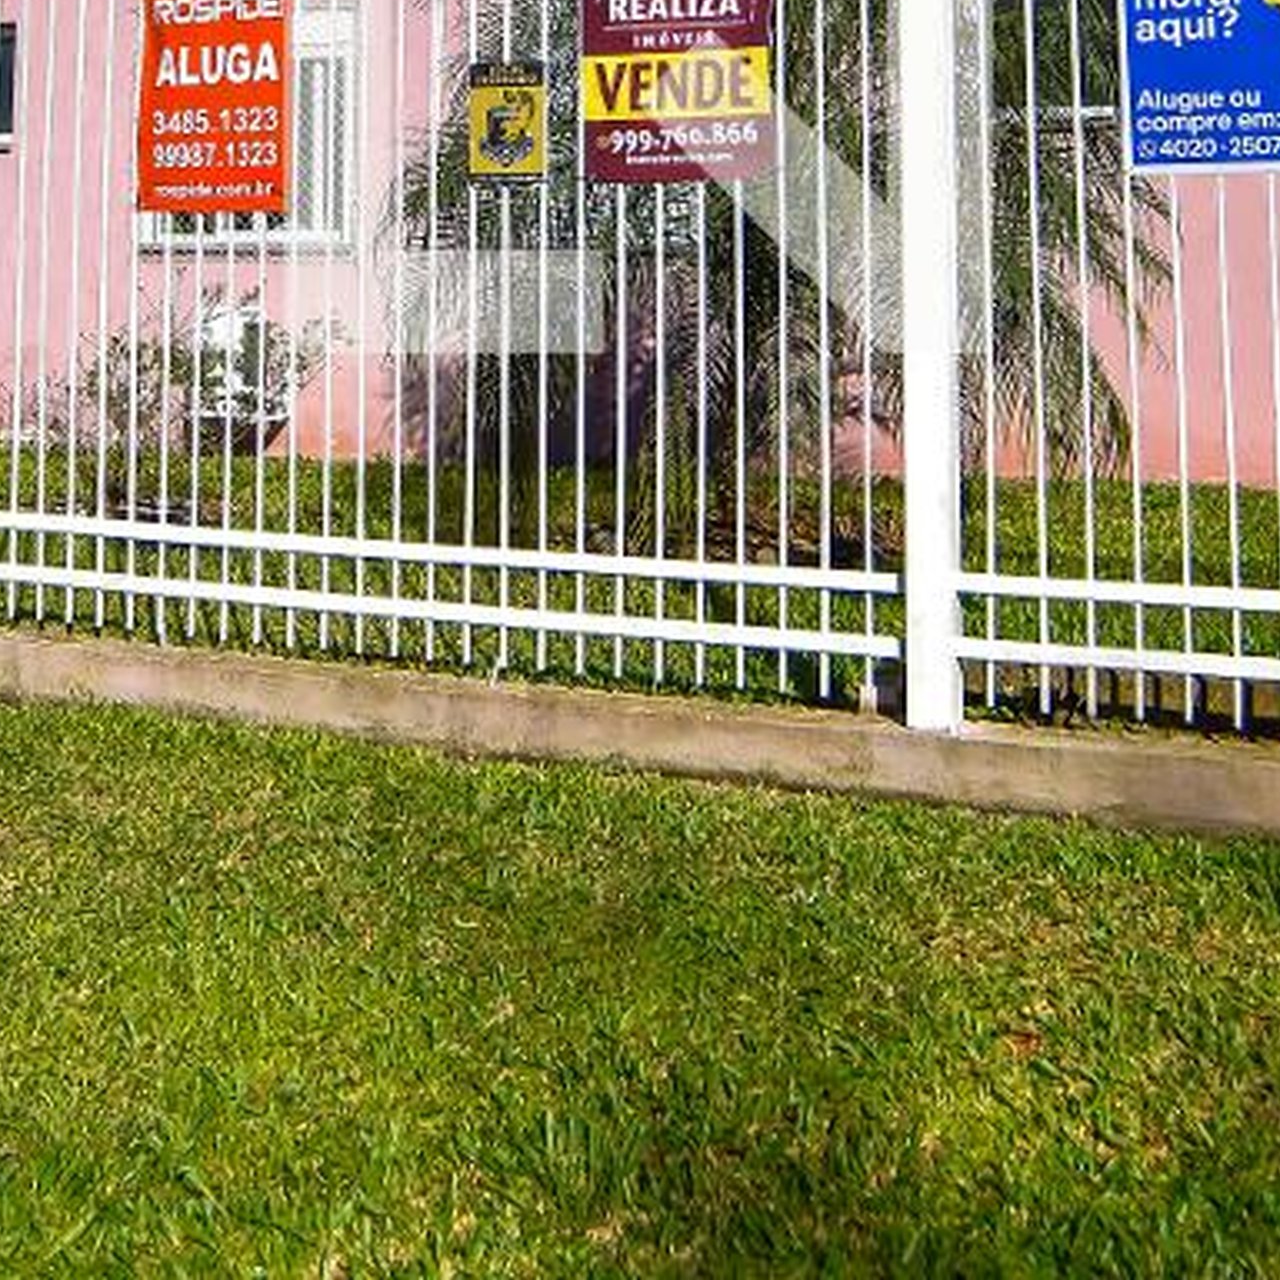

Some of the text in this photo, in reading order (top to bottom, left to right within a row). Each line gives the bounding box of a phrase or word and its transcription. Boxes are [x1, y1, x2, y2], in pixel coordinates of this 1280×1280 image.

[1136, 7, 1241, 48] aqui?
[155, 41, 279, 87] ALUGA
[595, 57, 754, 113] VENDE
[1137, 89, 1261, 114] Alugue ou
[1136, 114, 1233, 136] compre
